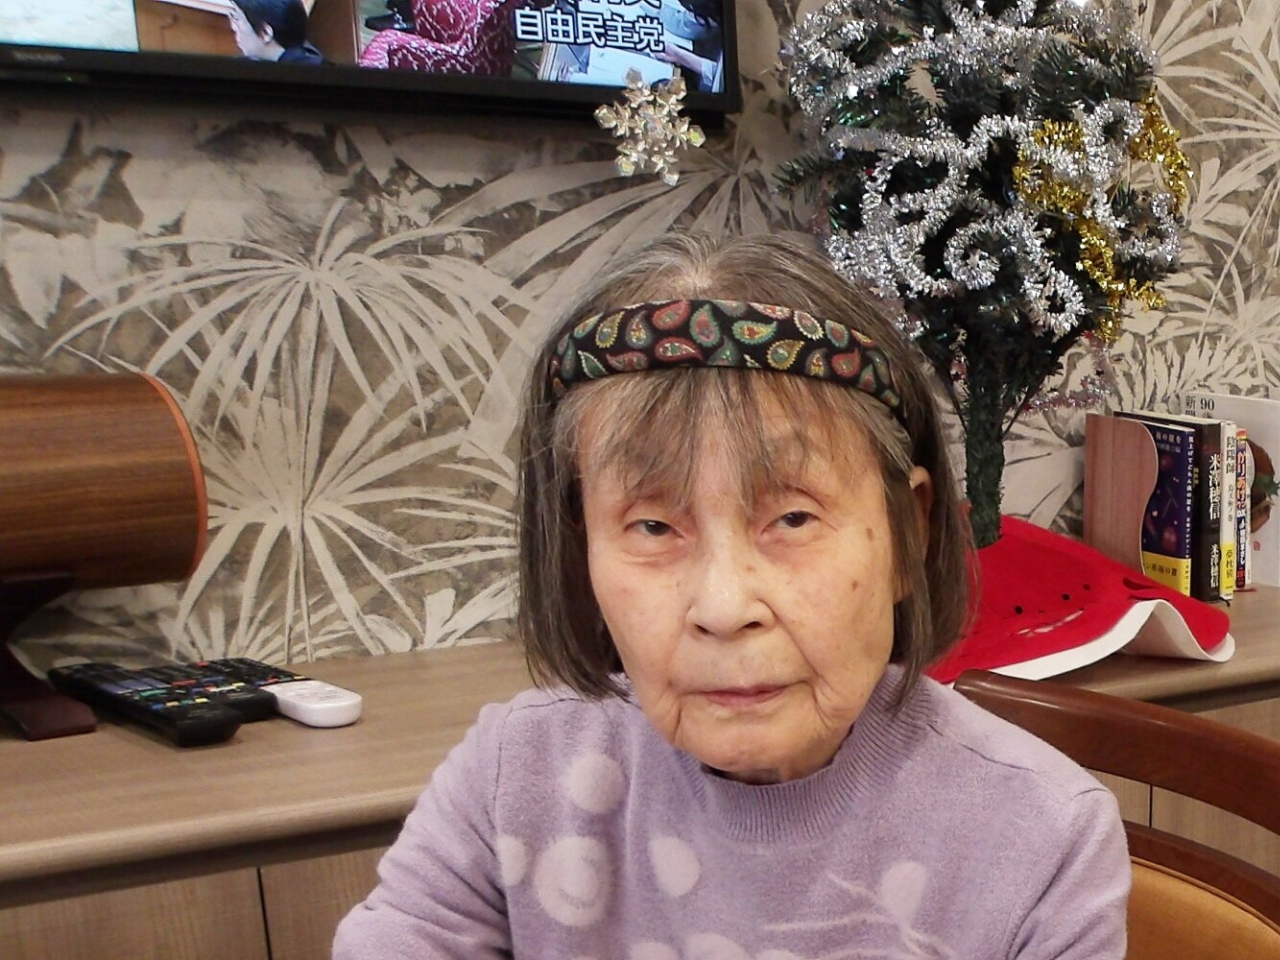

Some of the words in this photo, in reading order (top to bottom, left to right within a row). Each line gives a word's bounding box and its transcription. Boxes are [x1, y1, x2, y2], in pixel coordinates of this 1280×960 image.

[515, 6, 664, 52] 自由民主党
[1226, 436, 1235, 474] 陰陽師
